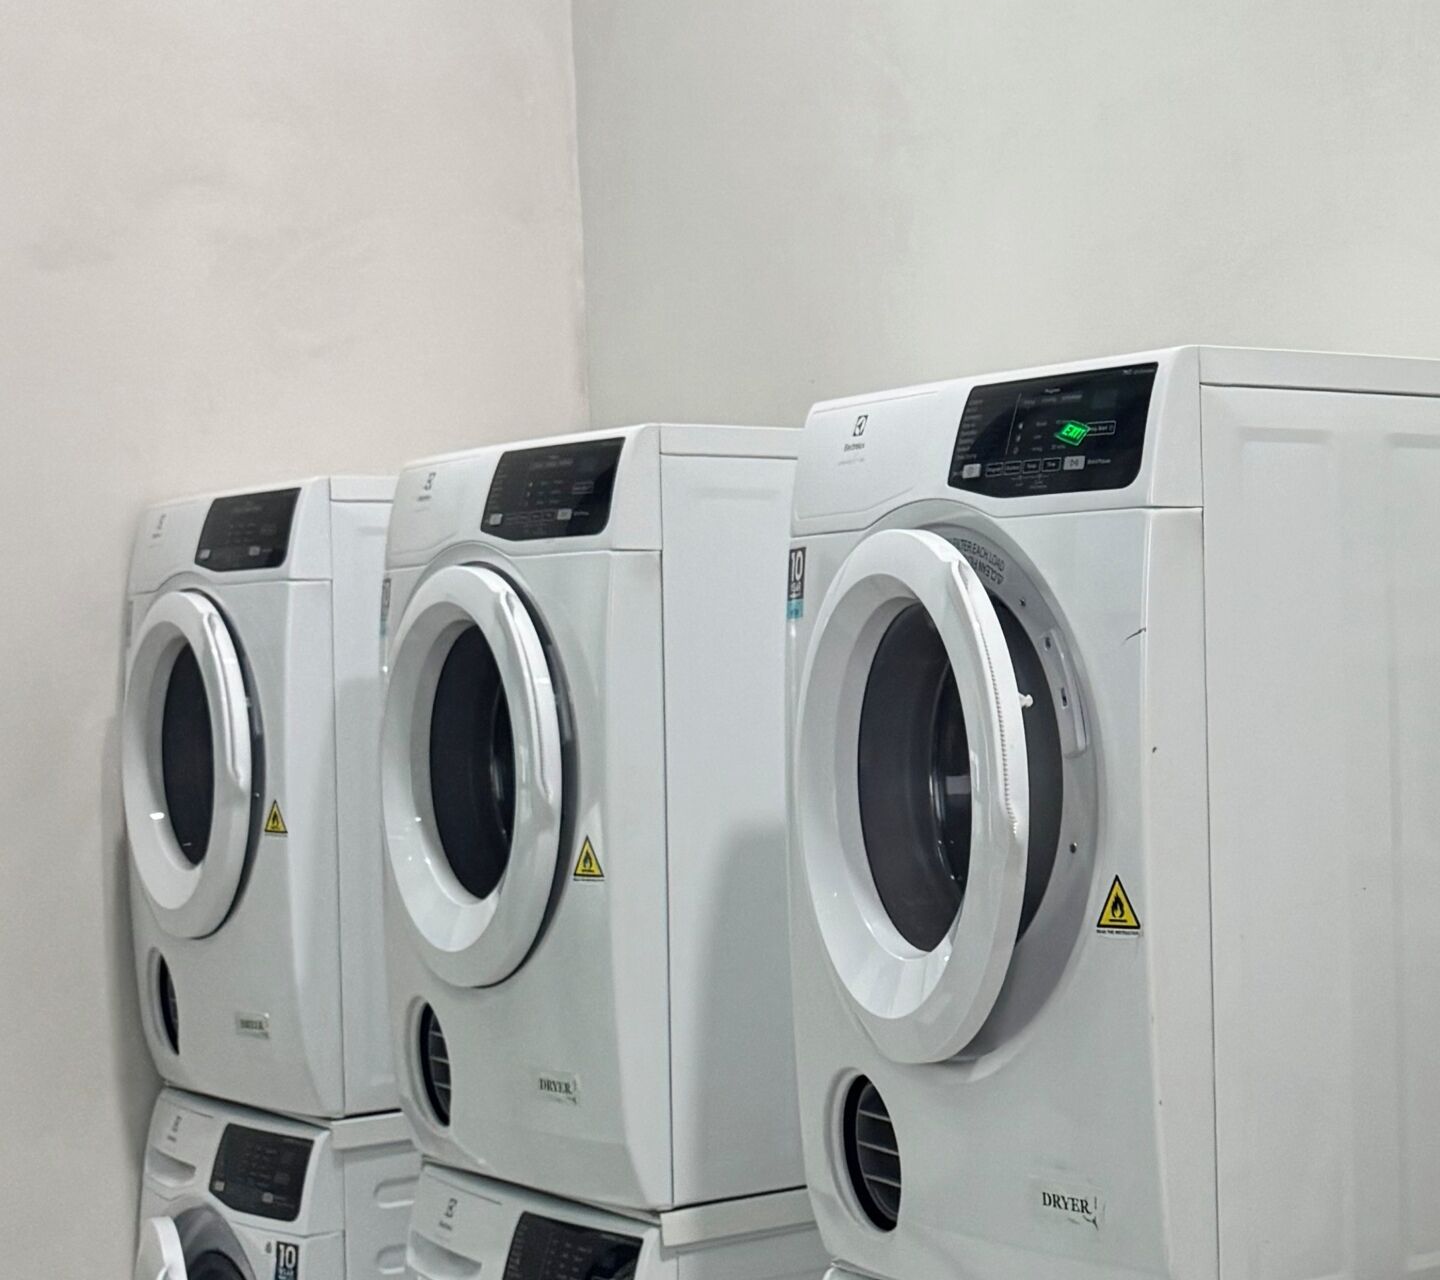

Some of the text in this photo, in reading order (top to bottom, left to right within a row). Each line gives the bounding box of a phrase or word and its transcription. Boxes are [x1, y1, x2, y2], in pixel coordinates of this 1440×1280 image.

[791, 549, 804, 582] 10
[1042, 1192, 1092, 1215] DRYER
[279, 1244, 296, 1269] 10
